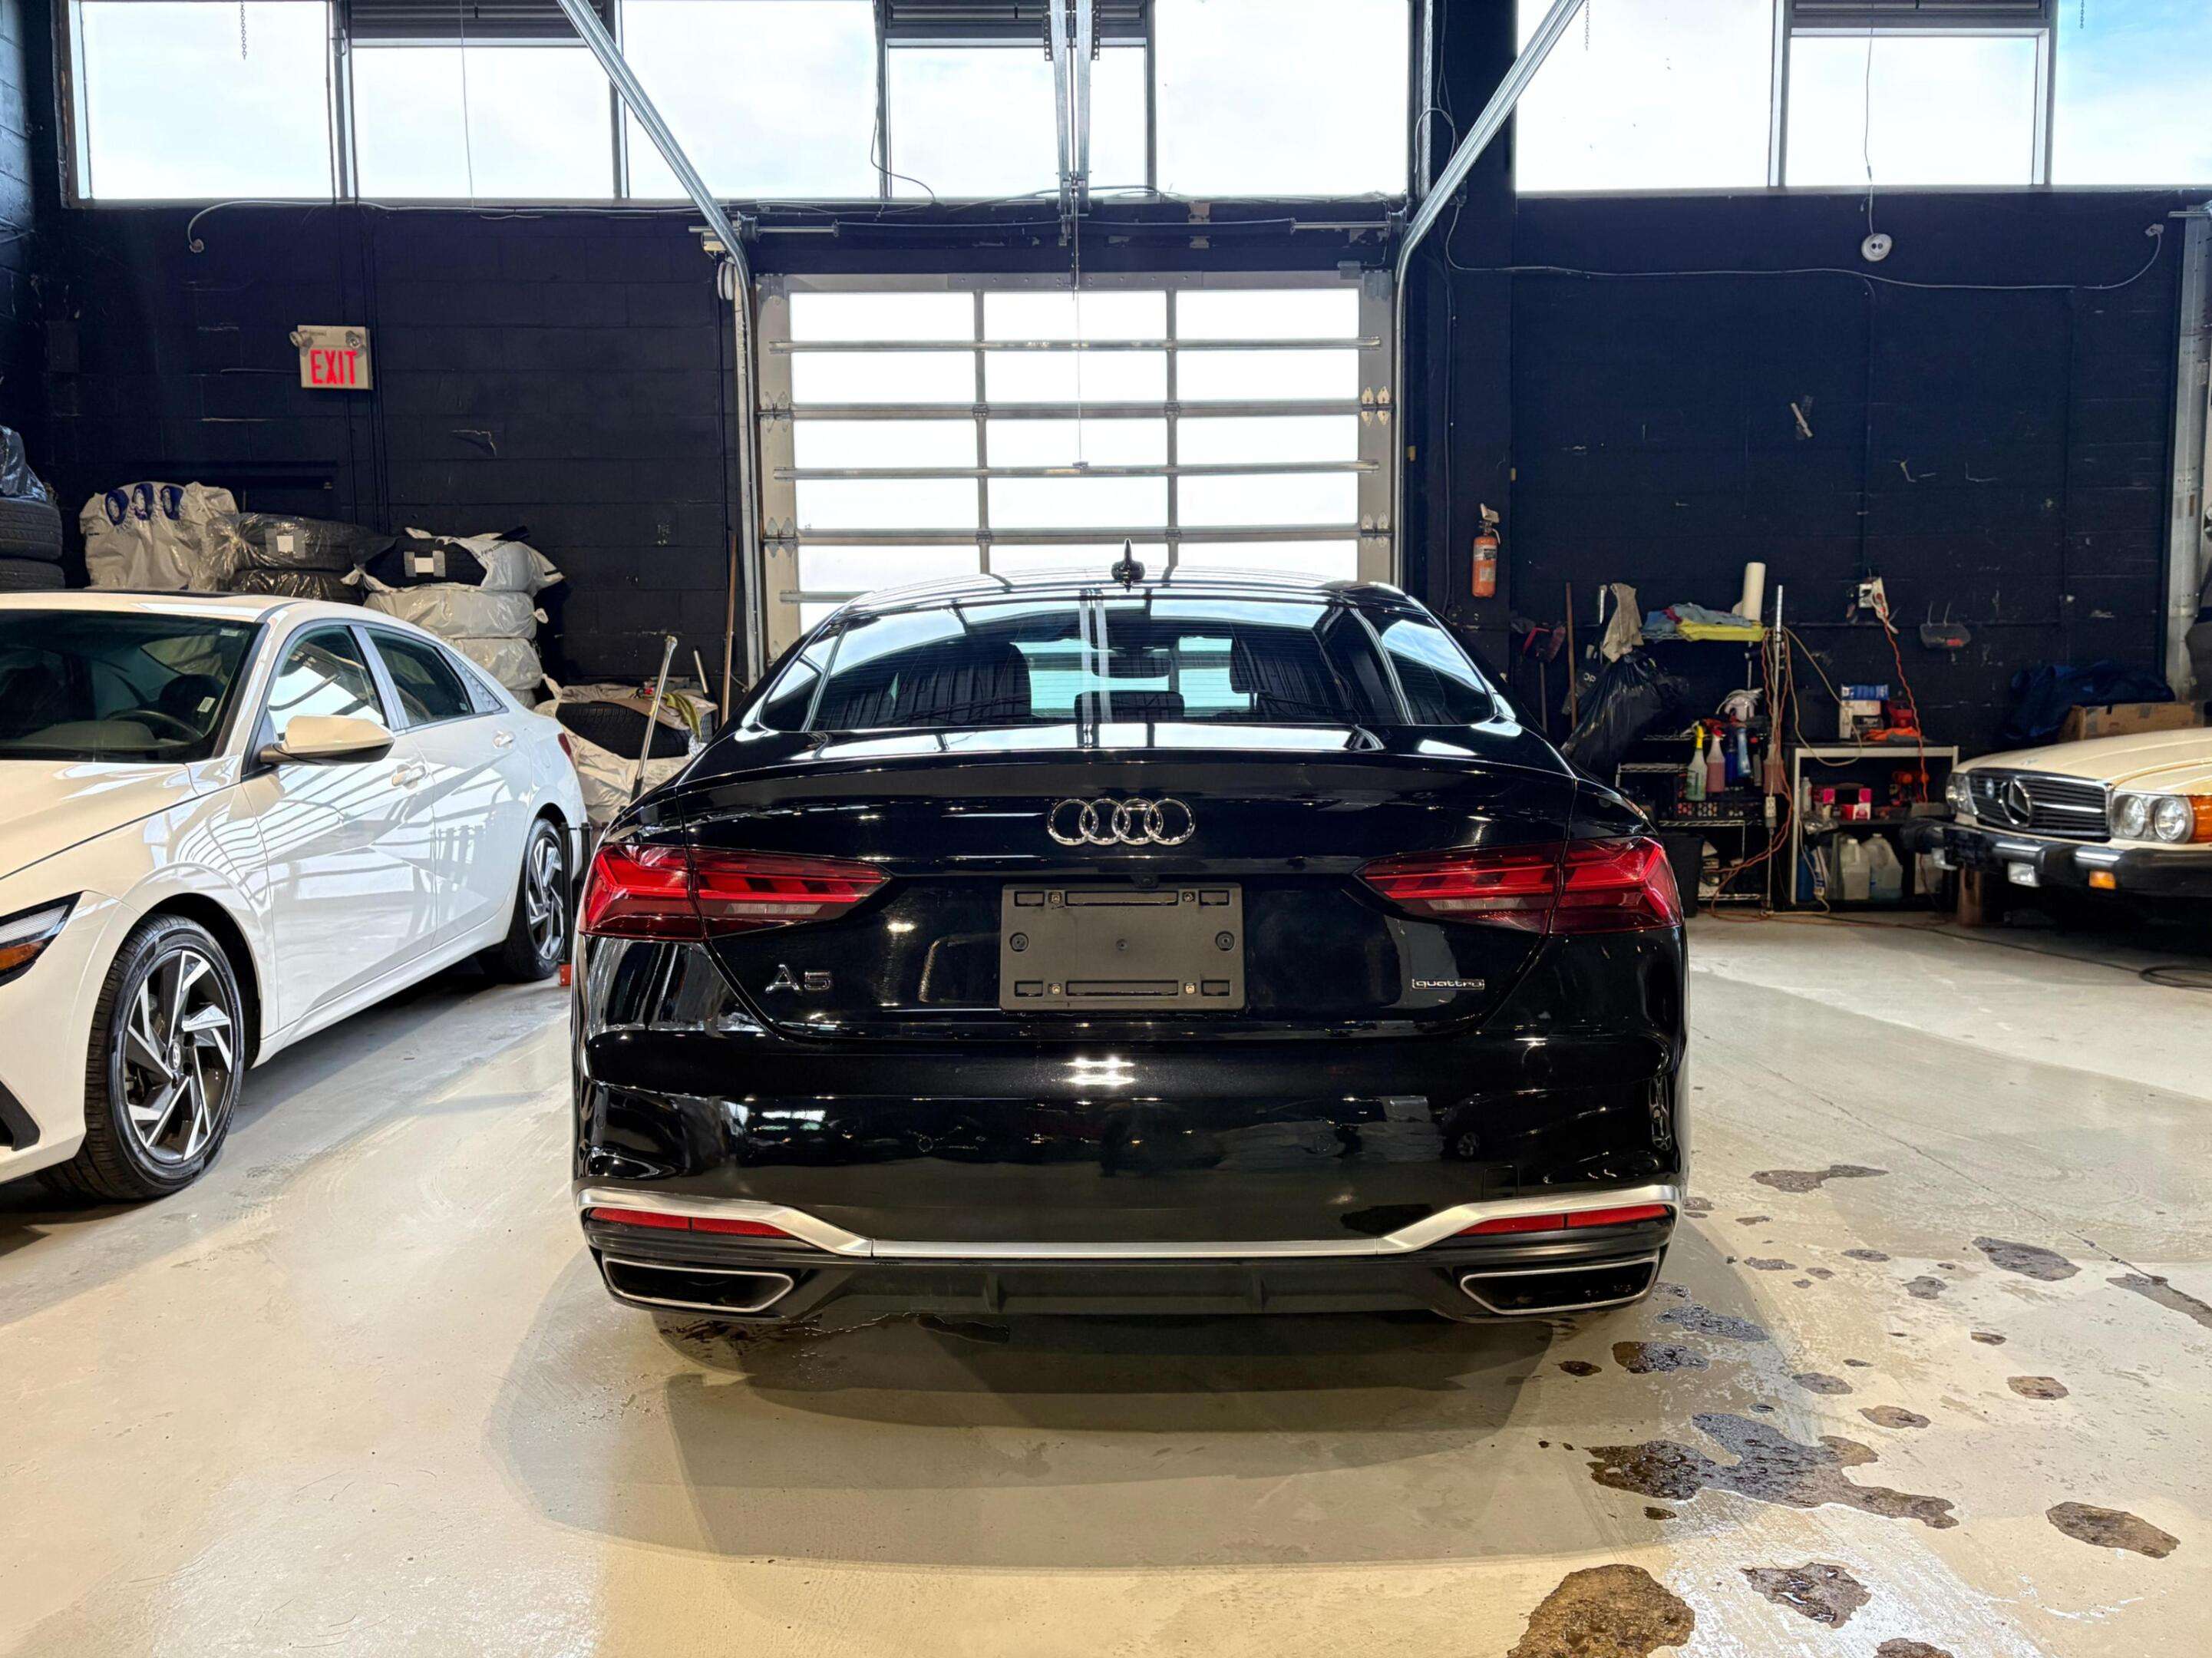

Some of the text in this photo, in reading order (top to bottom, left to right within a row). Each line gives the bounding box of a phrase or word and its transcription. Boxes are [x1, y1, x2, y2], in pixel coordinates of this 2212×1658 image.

[309, 349, 358, 385] EXIT
[765, 964, 831, 993] A5
[1415, 979, 1483, 989] quattro
